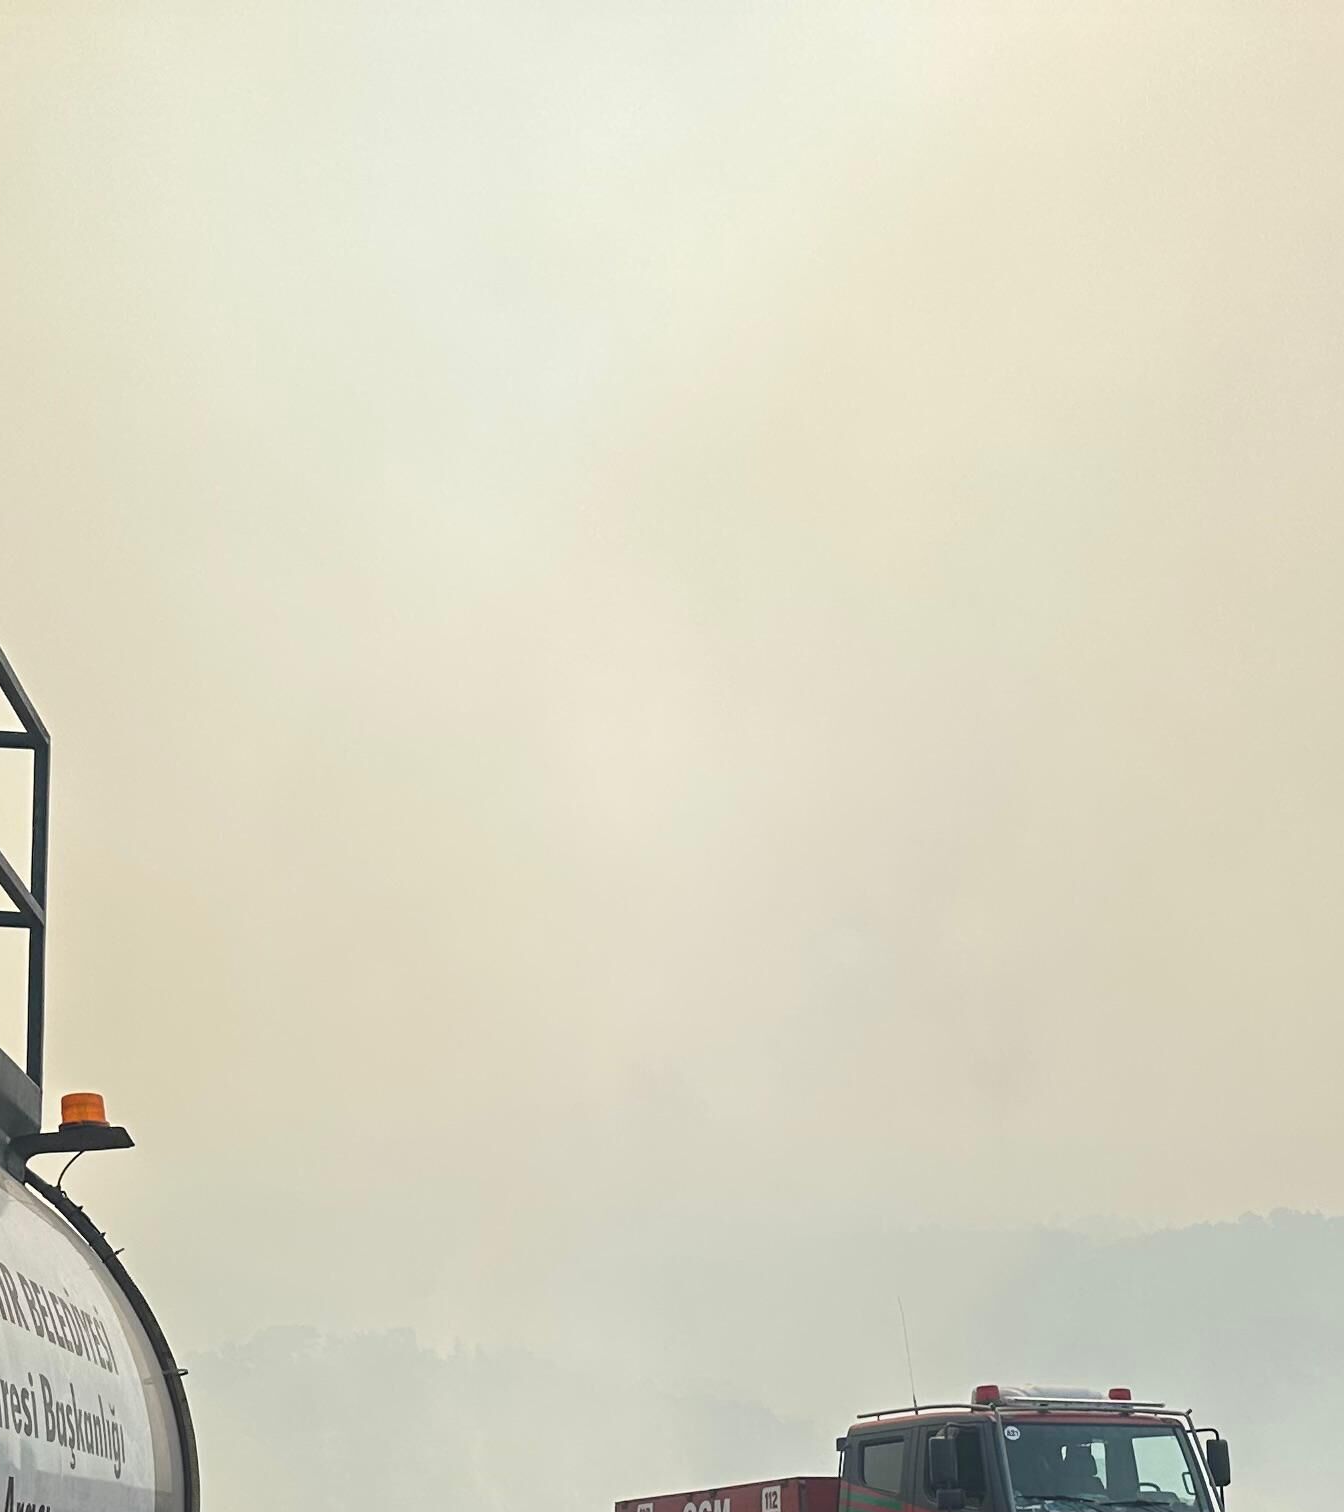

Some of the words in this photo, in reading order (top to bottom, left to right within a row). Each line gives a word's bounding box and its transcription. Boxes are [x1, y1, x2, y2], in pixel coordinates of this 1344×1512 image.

[17, 1271, 119, 1376] BELEDİYESİ
[39, 1373, 126, 1479] Başkanlığı
[765, 1491, 779, 1510] 112
